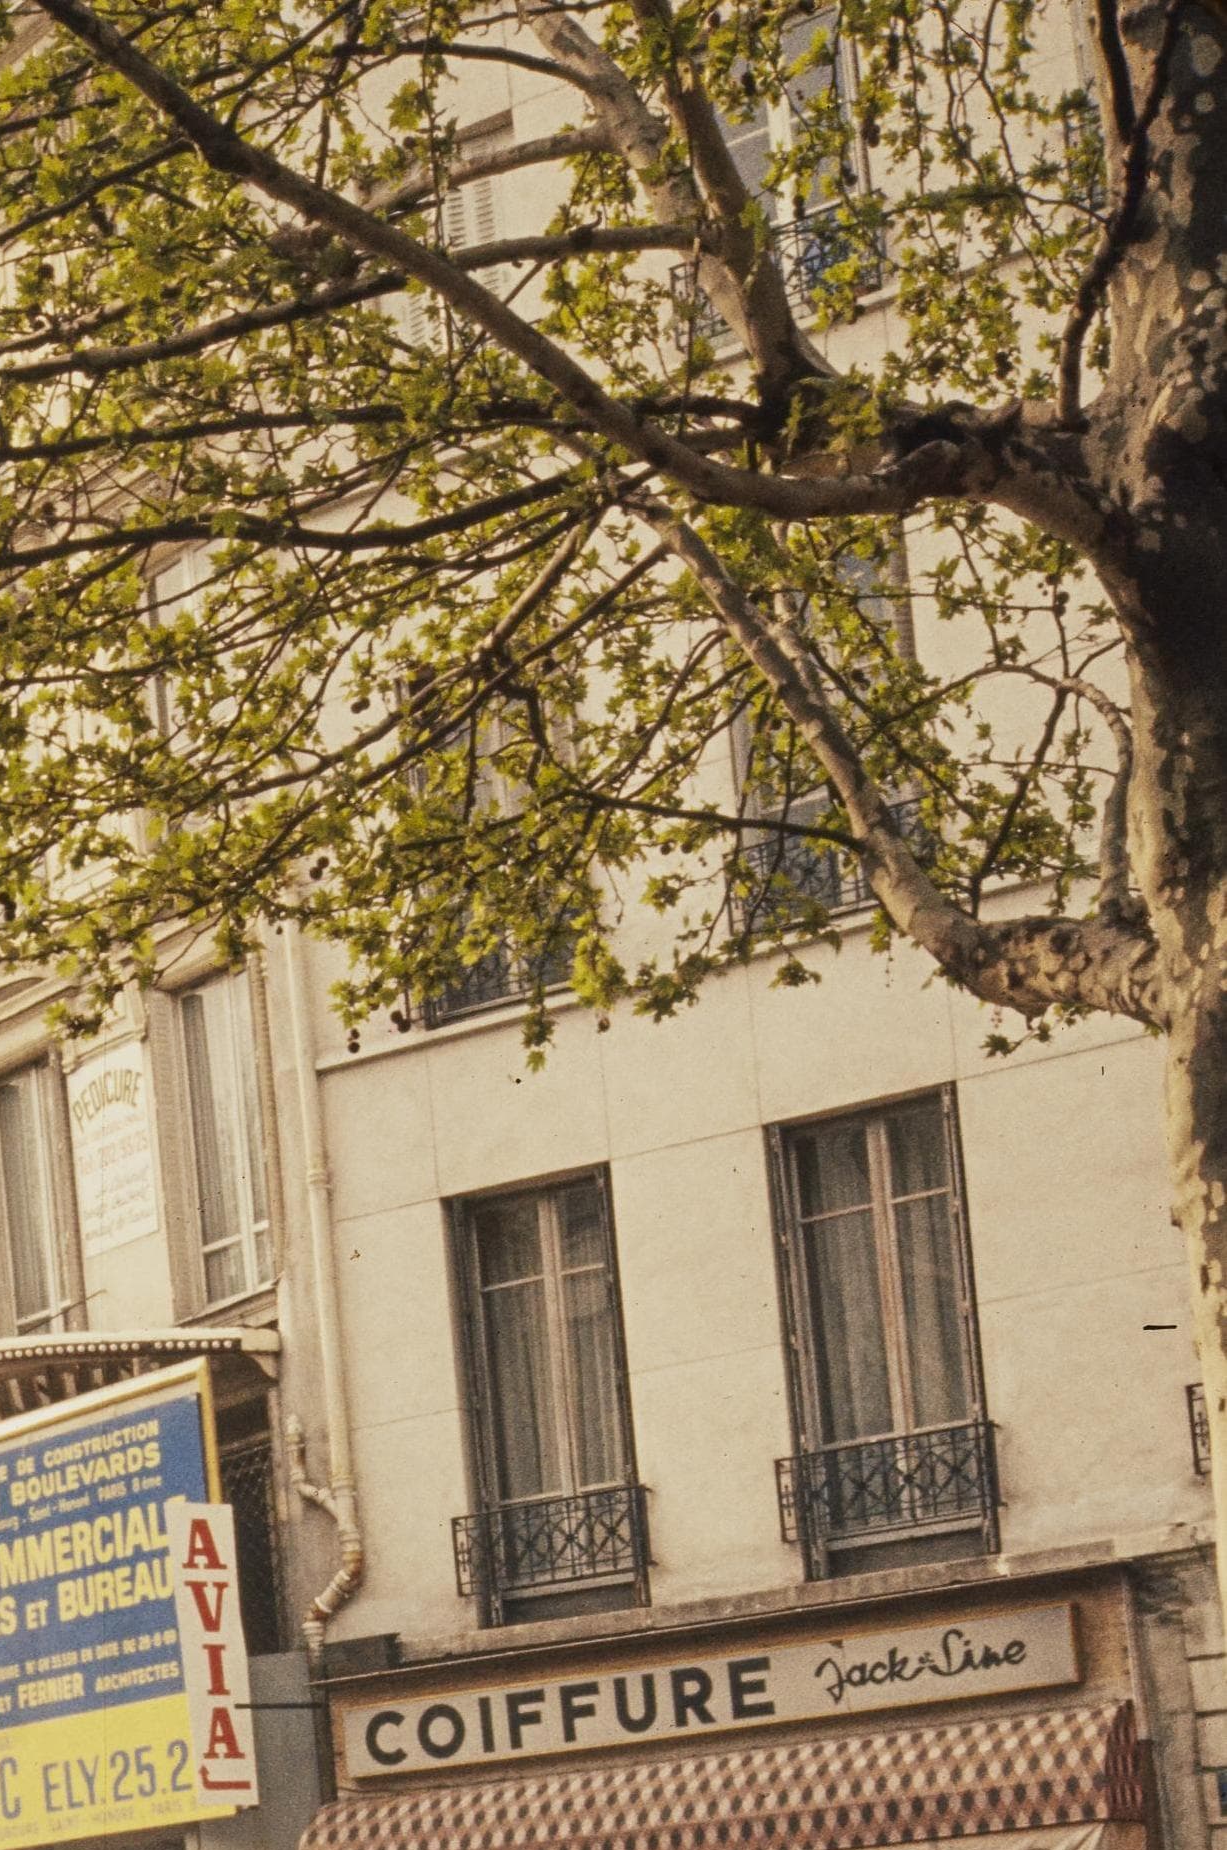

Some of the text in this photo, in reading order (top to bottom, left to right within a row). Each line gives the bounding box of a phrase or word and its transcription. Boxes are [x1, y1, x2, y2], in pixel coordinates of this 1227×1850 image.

[74, 1068, 143, 1131] PEDICURE
[10, 1442, 162, 1507] BOULEVARDS
[16, 1456, 36, 1477] DE
[43, 1419, 160, 1469] CONSTRUCTION
[26, 1599, 49, 1631] ET
[57, 1555, 174, 1623] BUREAU
[182, 1518, 245, 1759] AVIA
[95, 1660, 180, 1693] ARCHITECTES
[365, 1655, 777, 1766] COIFFURE
[814, 1646, 922, 1705] Jack
